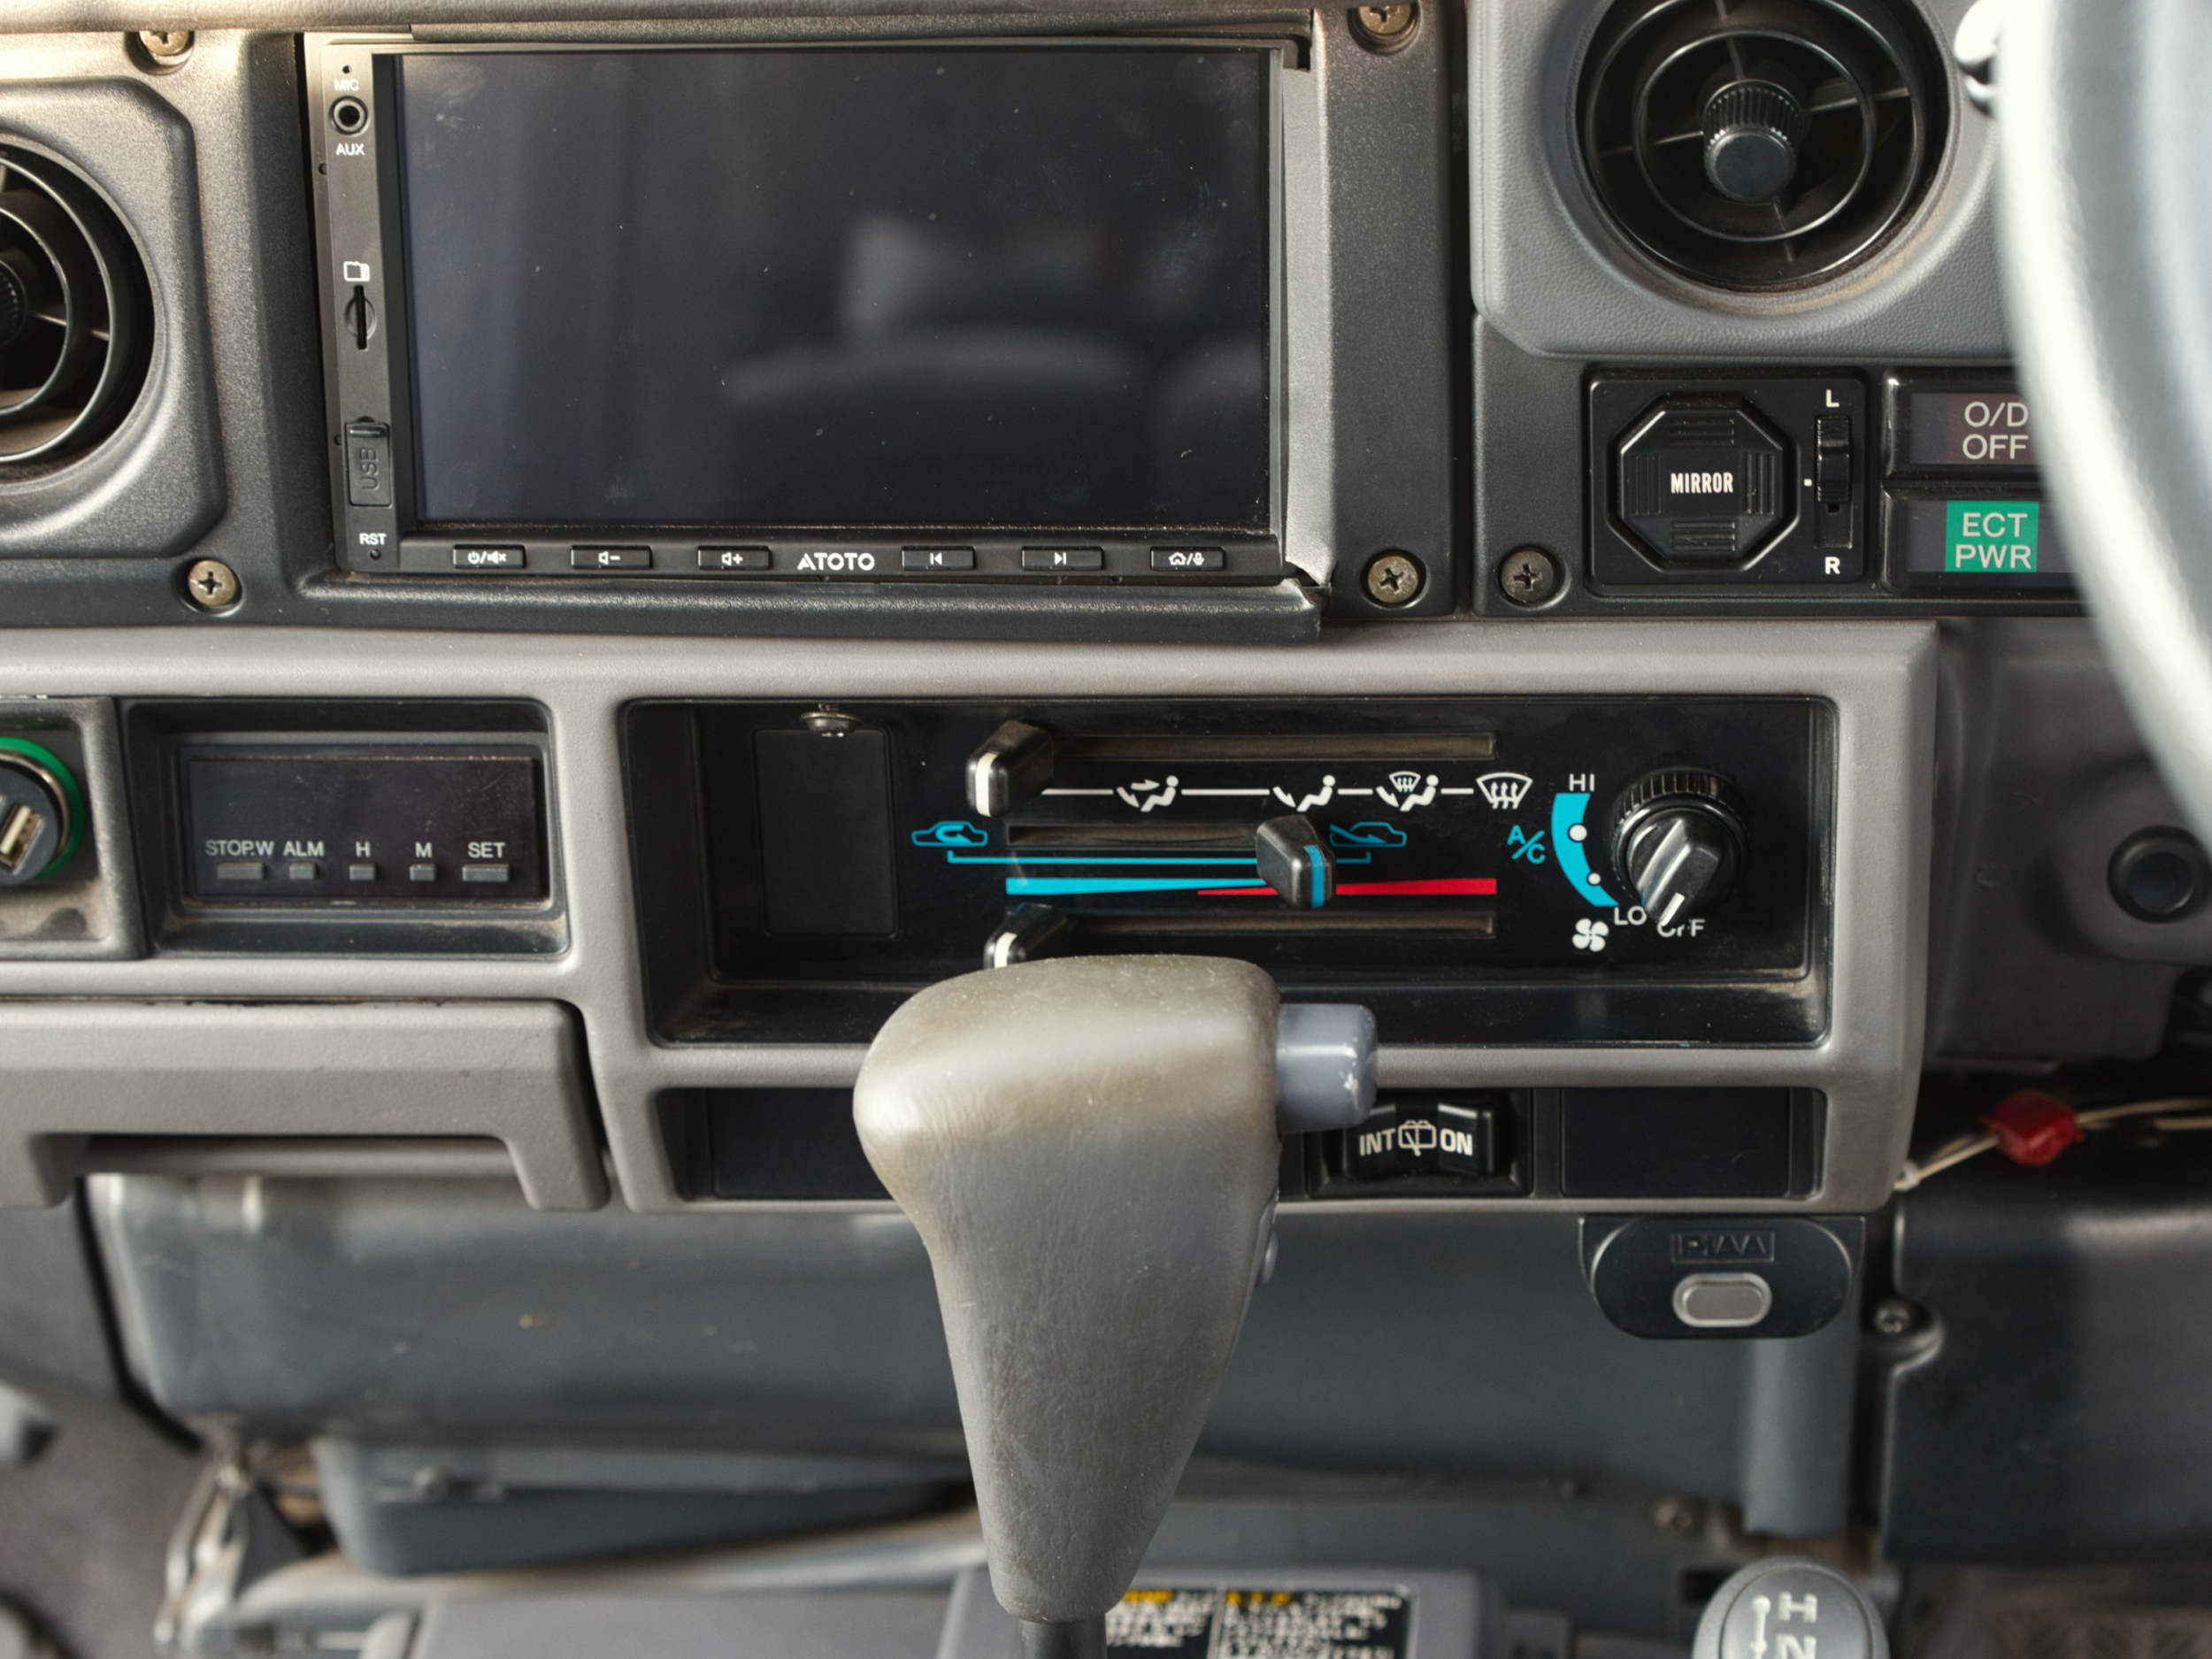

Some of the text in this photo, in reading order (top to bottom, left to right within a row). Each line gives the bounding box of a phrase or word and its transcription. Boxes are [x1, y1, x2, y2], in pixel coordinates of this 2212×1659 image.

[334, 79, 360, 92] MIC
[335, 142, 365, 156] AUX
[1825, 389, 1840, 408] L
[1963, 402, 2030, 427] O/D
[1962, 434, 2030, 460] OFF
[359, 446, 380, 491] USB
[1670, 472, 1734, 494] MIRROR
[1962, 511, 2029, 537] ECT
[359, 533, 388, 545] RST
[796, 552, 876, 571] ATOTO
[1824, 557, 1841, 575] R
[1955, 543, 2032, 569] PWR
[1569, 773, 1595, 792] HI
[283, 841, 325, 857] ALM
[356, 841, 371, 858] H
[415, 841, 433, 858] M
[467, 841, 506, 859] SET
[1507, 825, 1546, 864] A/C
[1613, 905, 1647, 926] LO
[1359, 1127, 1396, 1156] INT
[1440, 1128, 1473, 1156] ON
[1777, 1591, 1818, 1624] H
[1776, 1632, 1816, 1659] N
